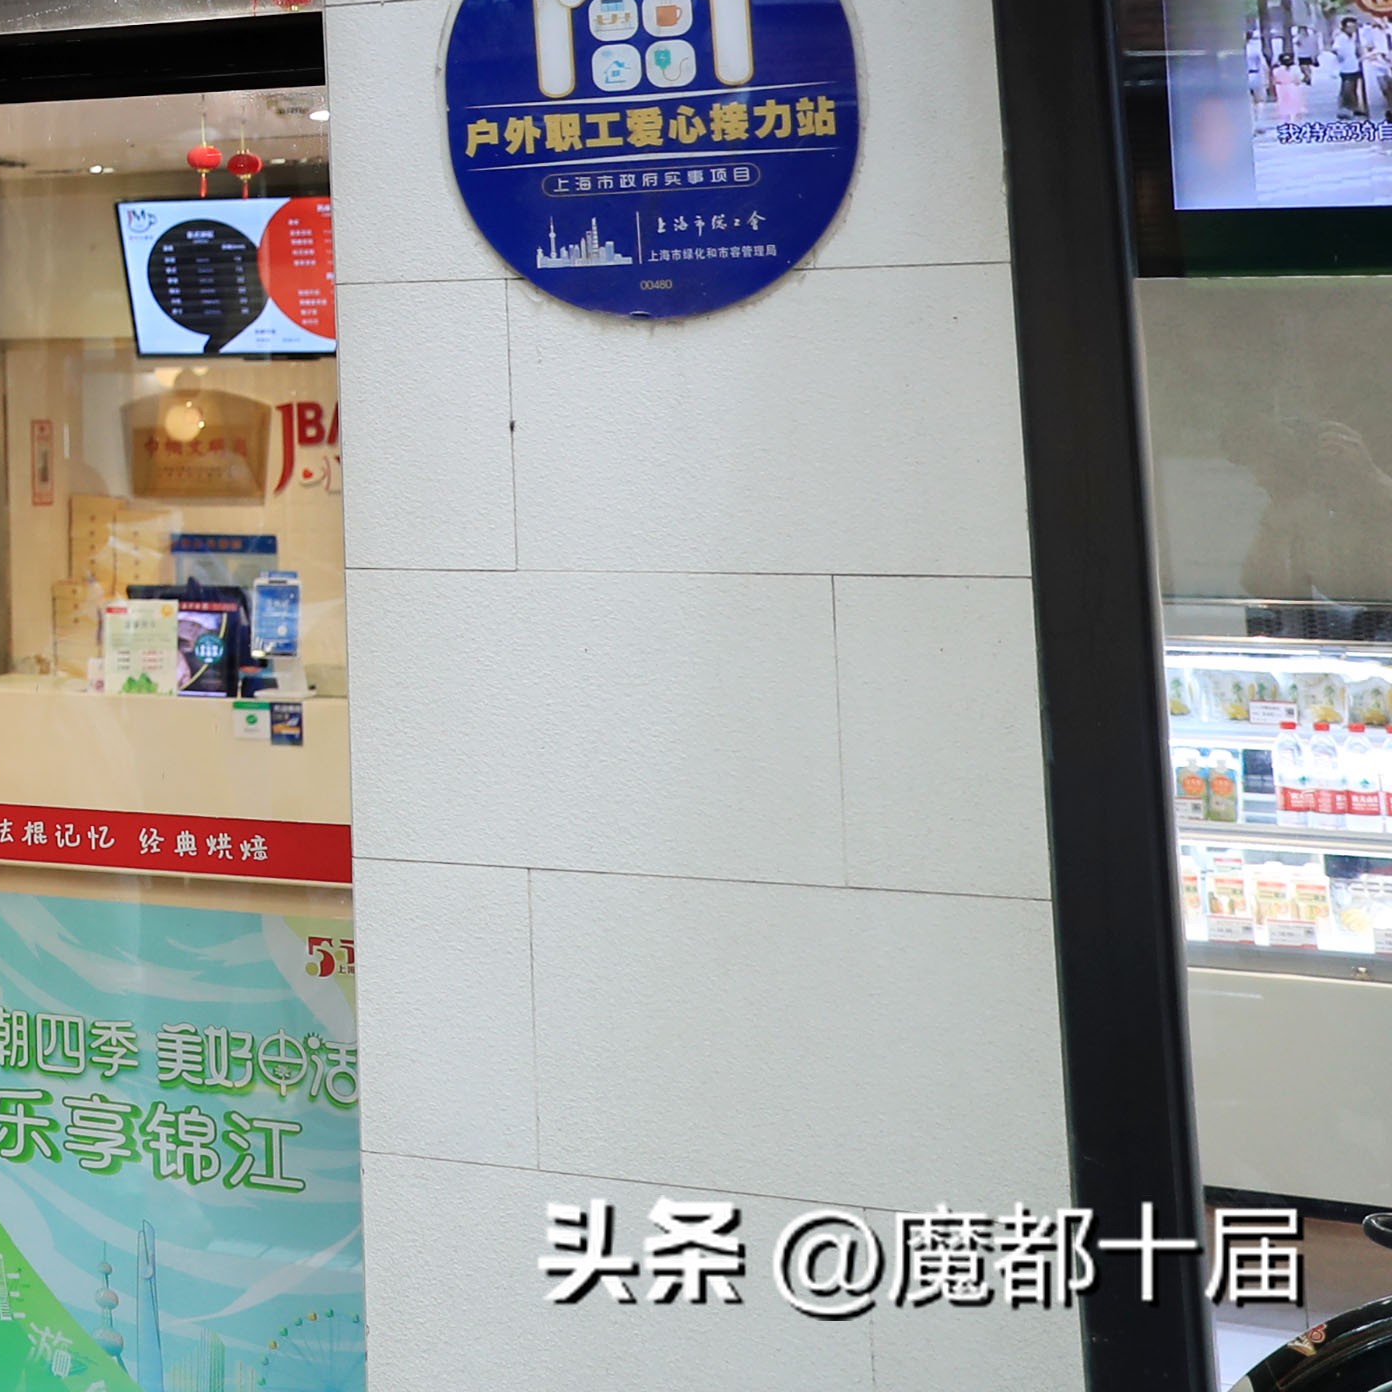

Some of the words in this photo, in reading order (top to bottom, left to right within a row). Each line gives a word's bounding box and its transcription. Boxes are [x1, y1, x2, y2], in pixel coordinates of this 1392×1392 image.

[465, 94, 837, 158] 户外职工爱心接力站
[552, 166, 752, 194] 上海市政府实事项目
[647, 244, 778, 263] 上海市绿化和市容管理局
[639, 278, 673, 291] 00480
[138, 827, 269, 862] 经典烘焙
